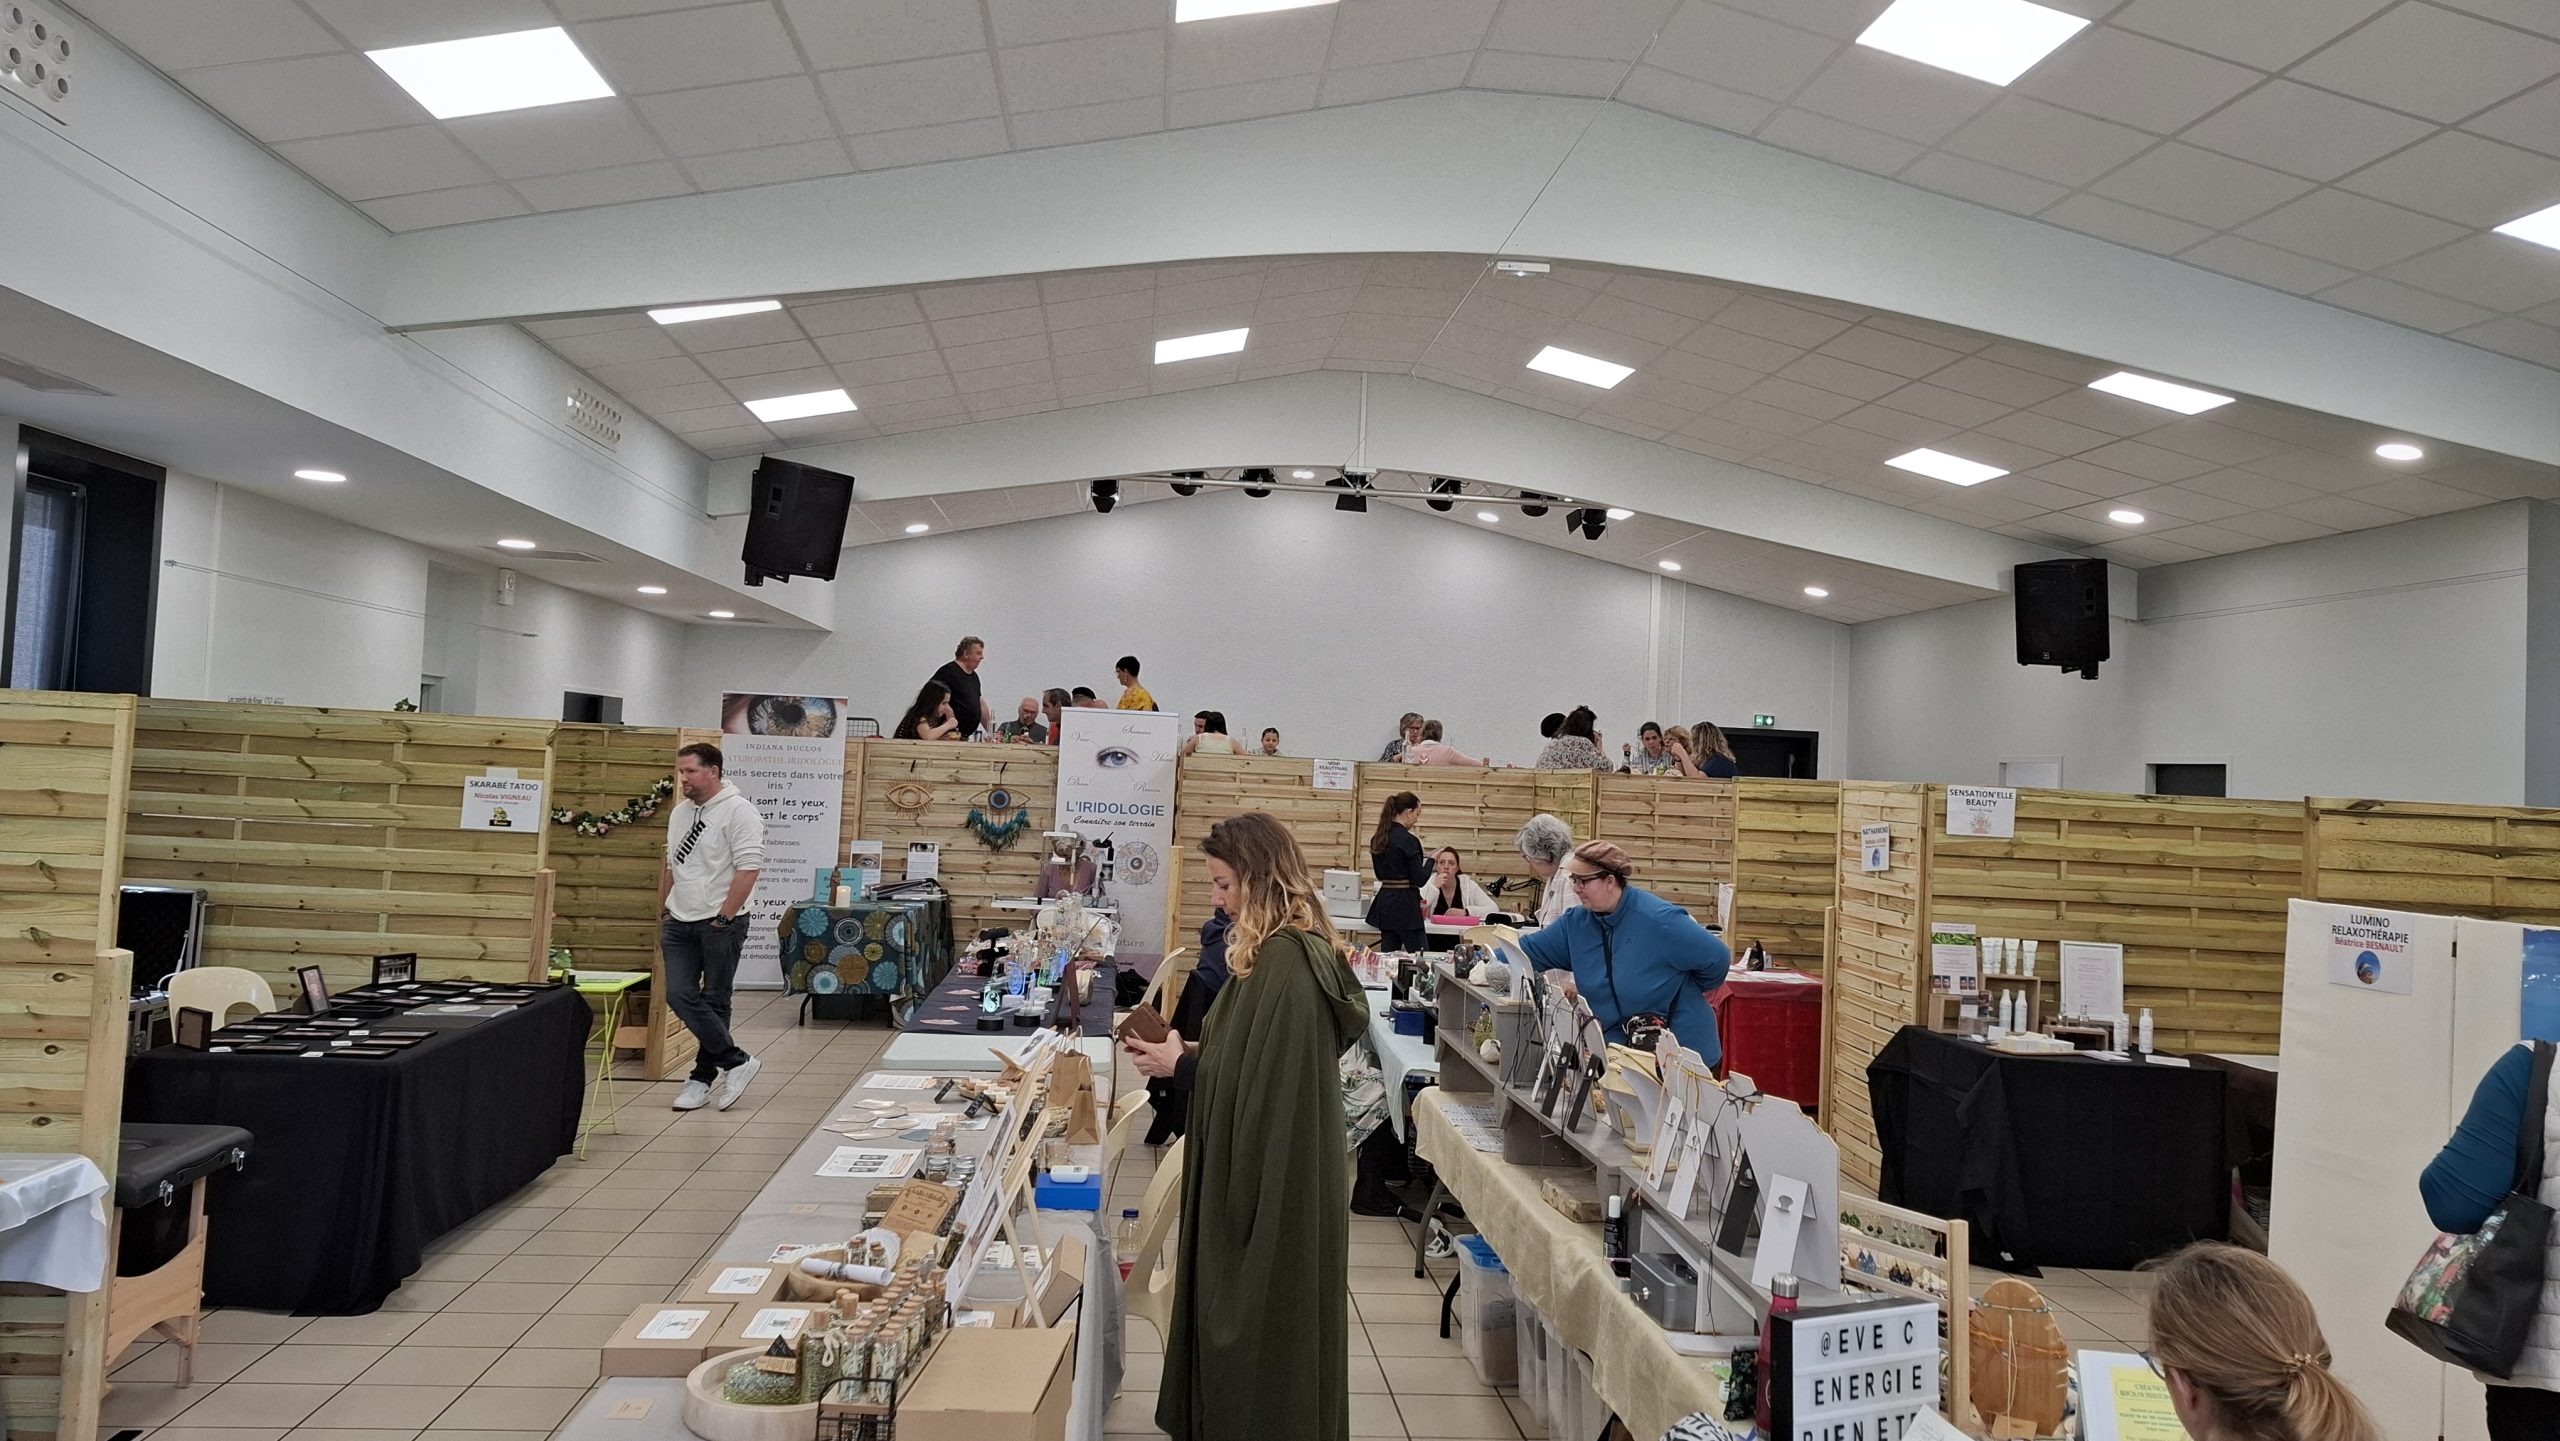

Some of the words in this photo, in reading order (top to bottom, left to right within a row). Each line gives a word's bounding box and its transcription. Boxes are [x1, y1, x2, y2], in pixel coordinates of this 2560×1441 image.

[745, 743, 784, 751] INDIANA
[750, 769, 787, 779] secrets
[790, 770, 815, 780] dans
[817, 772, 843, 780] votre
[469, 780, 507, 790] SKARABÉ
[509, 782, 539, 791] TATOO
[767, 781, 783, 790] iris
[474, 792, 499, 800] Nicolas
[1949, 788, 2014, 800] SENSATION'ELLE
[756, 797, 778, 806] sont
[782, 797, 797, 806] les
[1965, 798, 1998, 808] BEAUTY
[1065, 800, 1165, 817] L'IRIDOLOGIE
[778, 811, 788, 820] le
[1128, 820, 1156, 828] terrain
[762, 899, 787, 908] yeux
[2350, 914, 2390, 928] LUMINO
[2331, 925, 2409, 944] RELAXOTHÉRAPIE
[1116, 938, 1145, 948] aturo
[2334, 937, 2364, 949] Béatrice
[2365, 940, 2405, 953] BESNAULT
[1820, 1324, 1883, 1357] @EVE
[1903, 1320, 1914, 1345] C
[1814, 1364, 1922, 1406] ENERGIE
